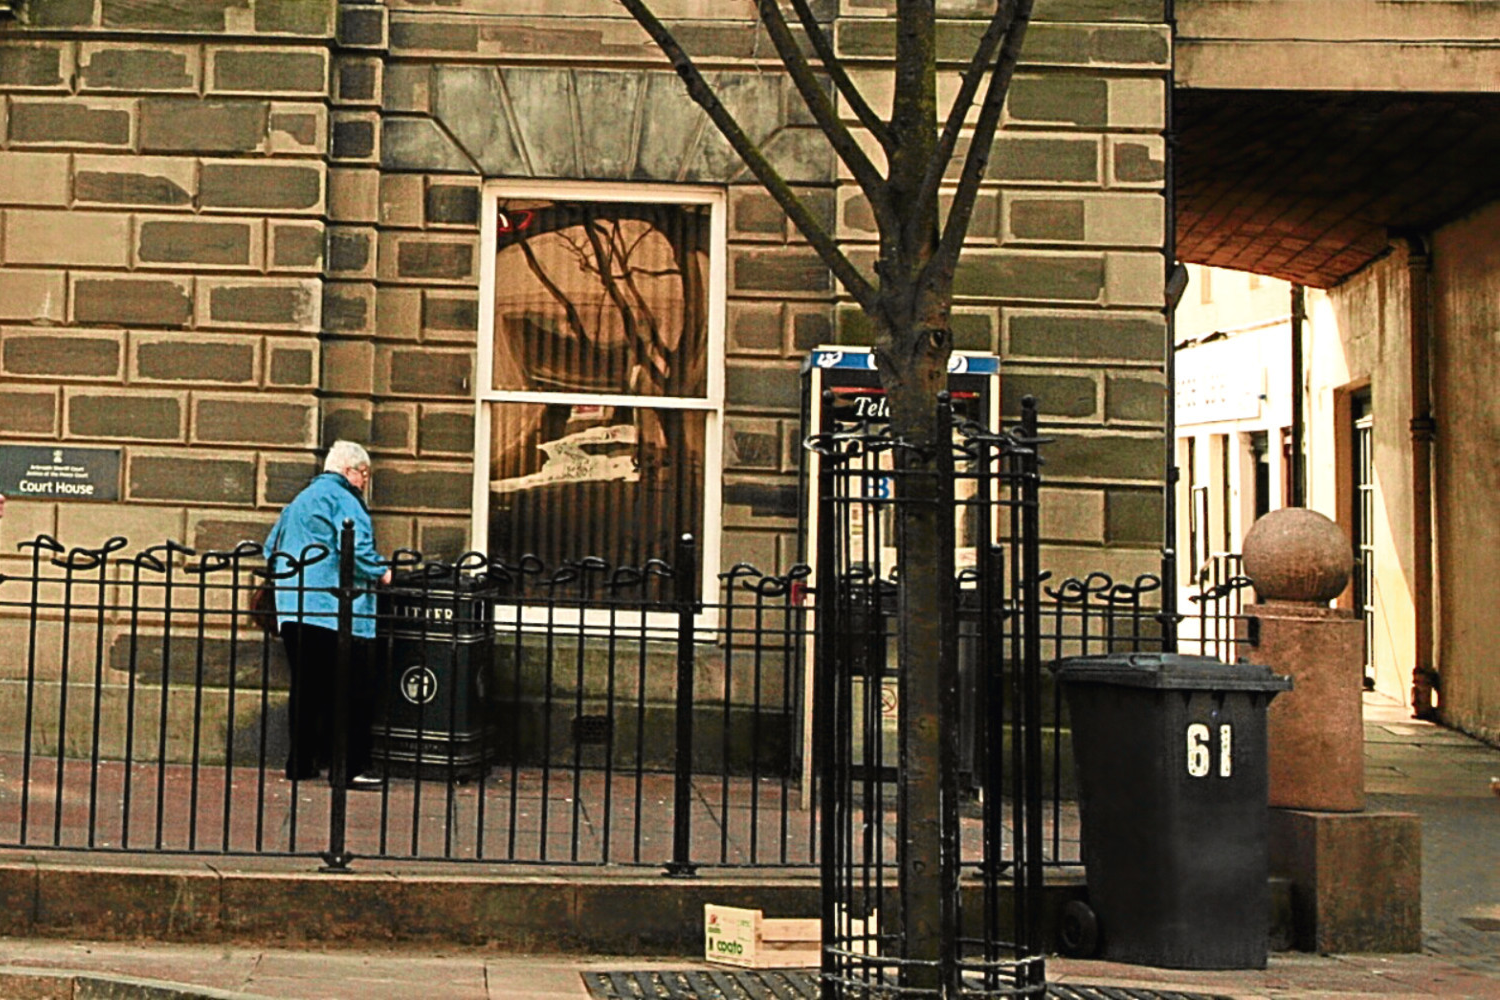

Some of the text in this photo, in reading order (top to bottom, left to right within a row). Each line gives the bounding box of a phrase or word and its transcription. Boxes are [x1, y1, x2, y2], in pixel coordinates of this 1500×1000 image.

[19, 480, 94, 494] Court House
[1187, 723, 1231, 777] 61
